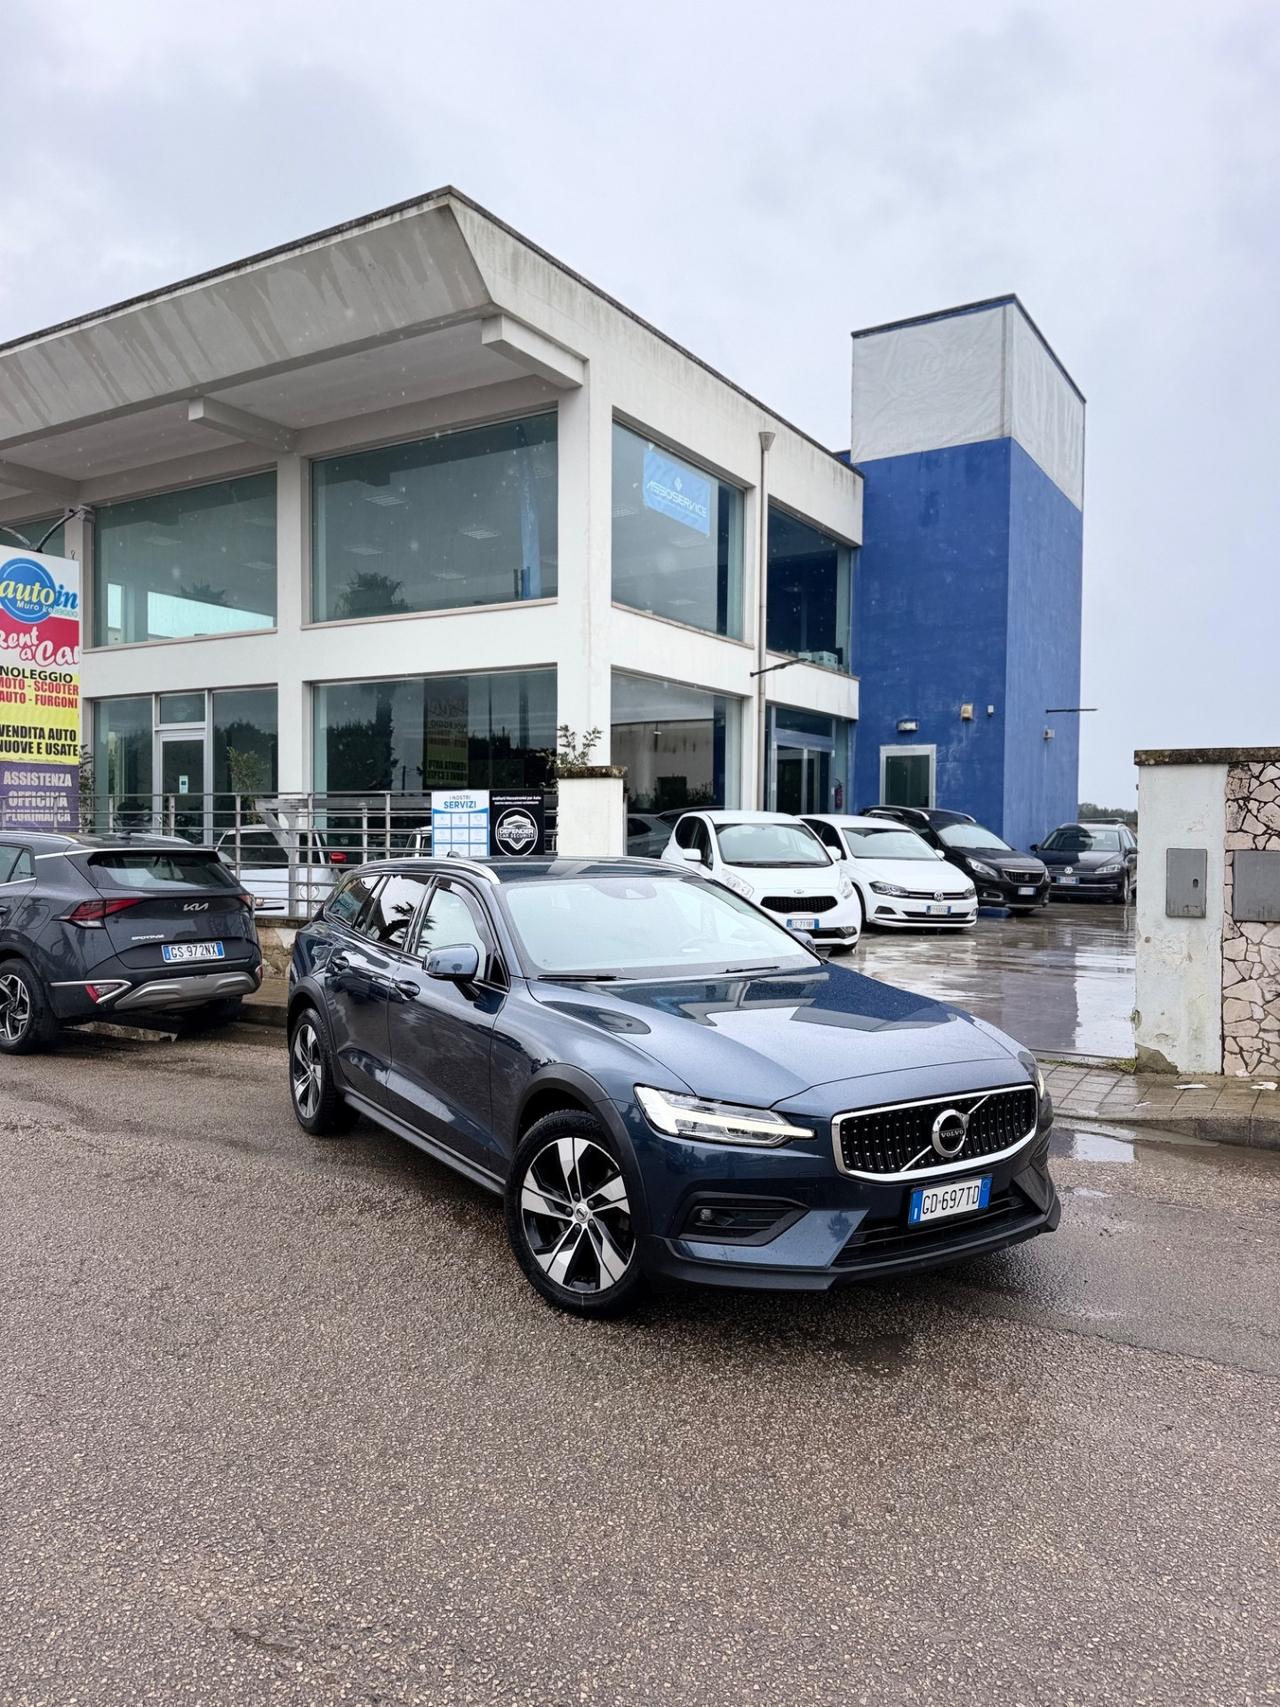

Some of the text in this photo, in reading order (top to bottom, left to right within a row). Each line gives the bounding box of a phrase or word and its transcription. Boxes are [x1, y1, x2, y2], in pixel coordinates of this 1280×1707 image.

[17, 600, 39, 611] Muro
[0, 665, 73, 684] NOLEGGIO
[34, 680, 79, 696] SCOOTER
[0, 691, 26, 704] AUTO
[35, 694, 78, 709] FURGONI
[0, 724, 77, 742] VENDITA AUTO
[37, 742, 43, 755] E
[45, 743, 78, 757] USATE
[4, 771, 72, 787] ASSISTENZA
[443, 801, 477, 809] SERVIZI
[941, 1129, 964, 1138] VOLVO
